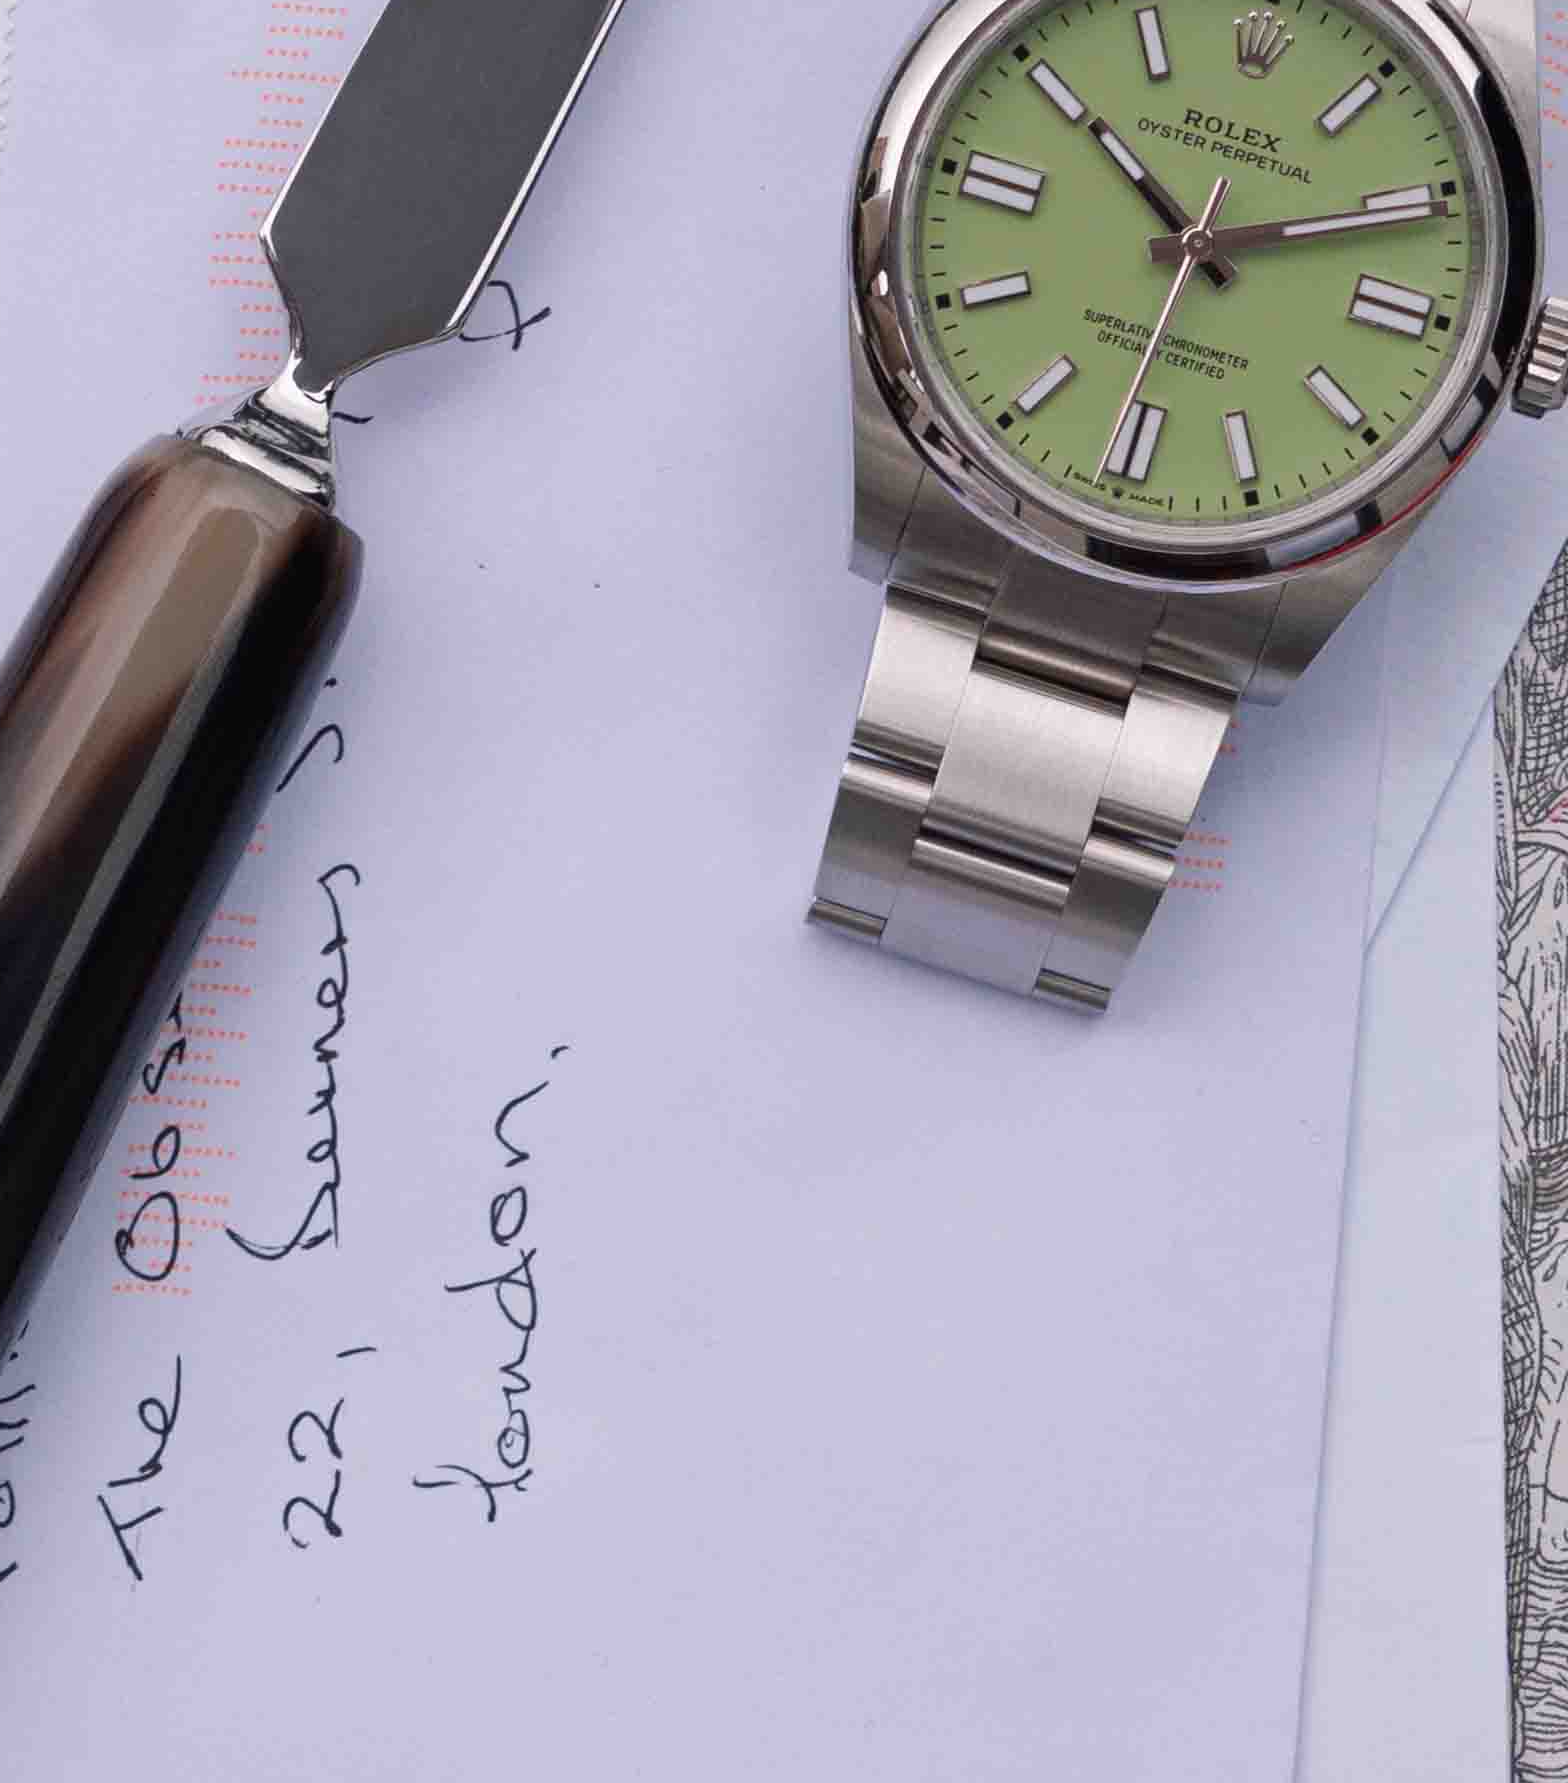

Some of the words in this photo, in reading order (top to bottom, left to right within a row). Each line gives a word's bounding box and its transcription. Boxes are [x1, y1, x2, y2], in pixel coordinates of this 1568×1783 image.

[1137, 117, 1207, 152] OYSTER
[1210, 140, 1313, 185] PERPETUAL
[1183, 108, 1282, 153] ROLEX
[1083, 308, 1157, 341] SUPERLATIV
[1162, 333, 1249, 370] CHRONOMETER
[1096, 329, 1163, 361] OFFICIALY
[1164, 353, 1225, 380] CERTIFIED
[96, 1354, 183, 1581] The
